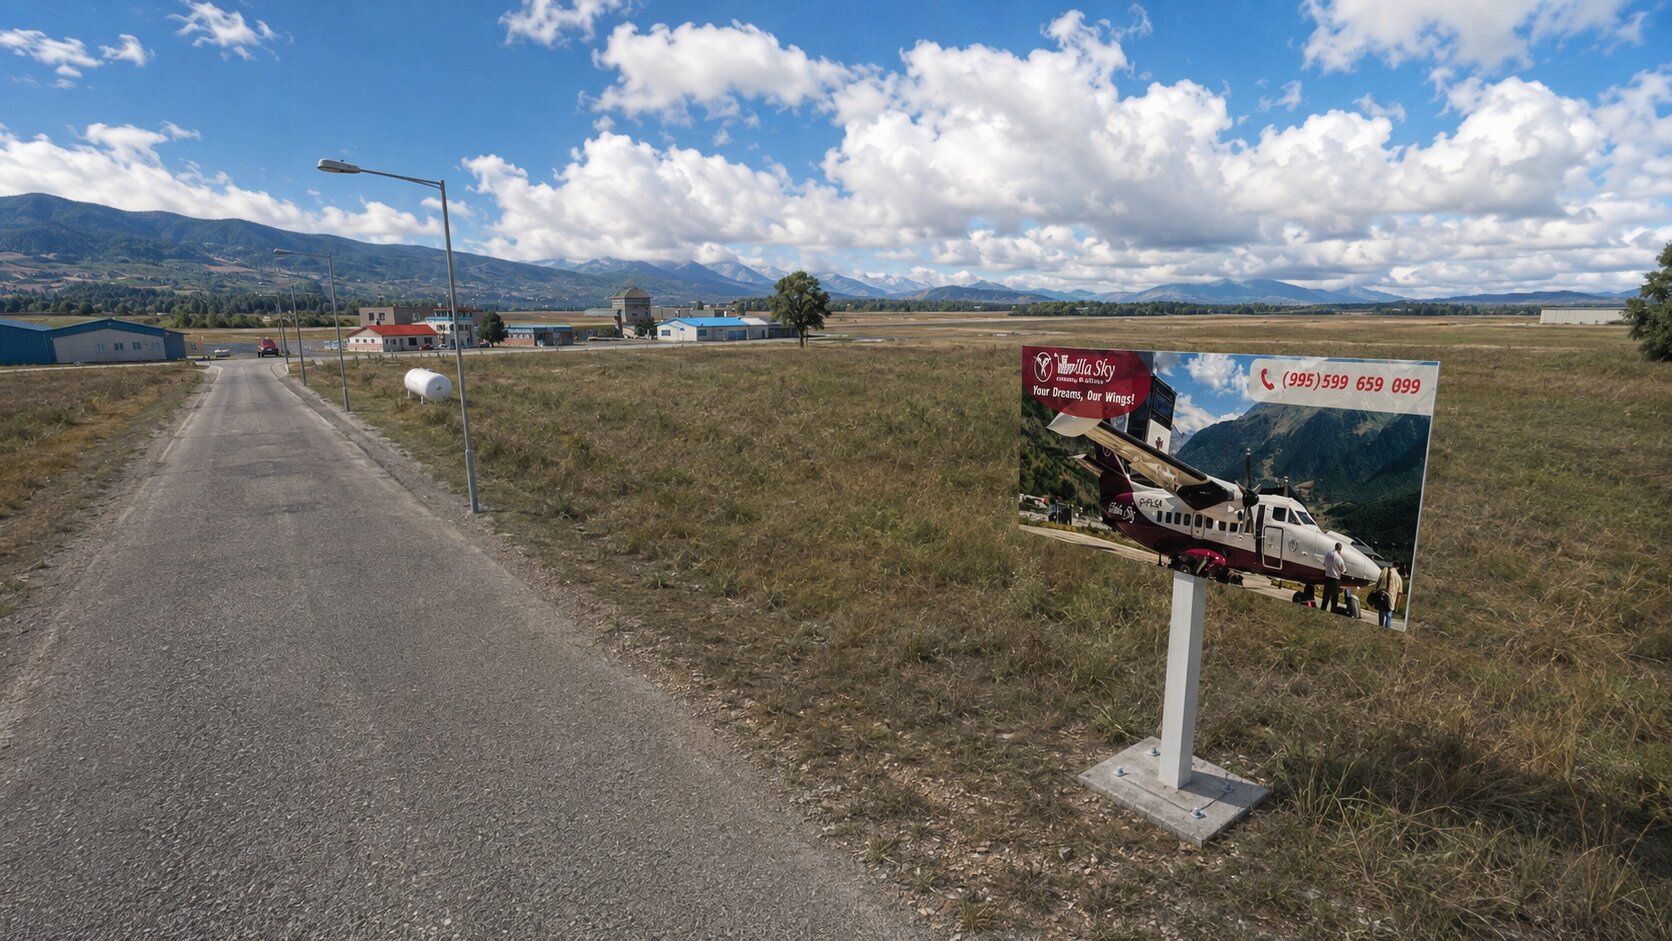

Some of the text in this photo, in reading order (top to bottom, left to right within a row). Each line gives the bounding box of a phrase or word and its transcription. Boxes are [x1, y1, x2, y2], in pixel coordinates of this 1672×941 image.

[1093, 358, 1115, 382] Sky
[1356, 375, 1384, 393] 659
[1391, 378, 1421, 394] 099
[1033, 385, 1135, 406] Your Dreams, Our Wings!
